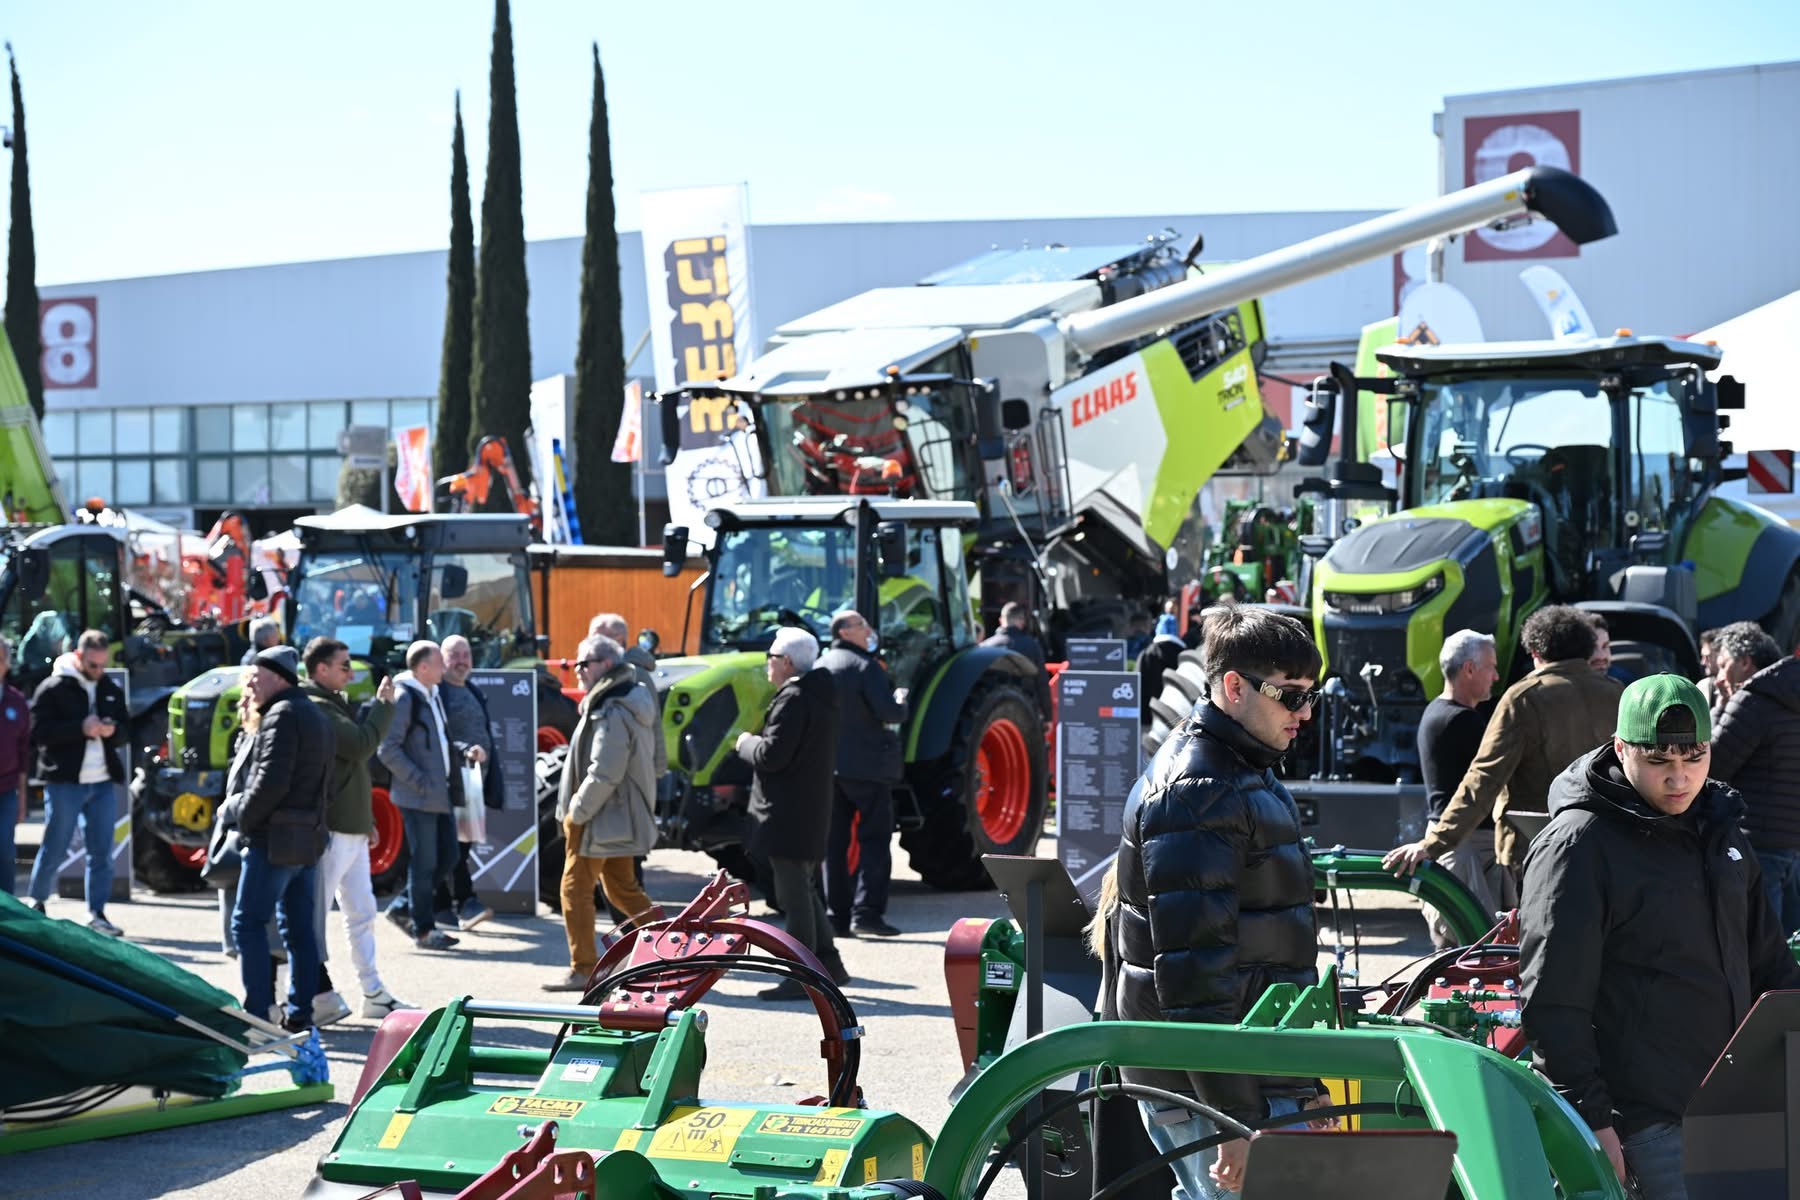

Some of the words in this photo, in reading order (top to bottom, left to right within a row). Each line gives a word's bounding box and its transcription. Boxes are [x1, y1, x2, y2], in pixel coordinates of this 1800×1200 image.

[42, 303, 93, 384] 8
[1072, 371, 1136, 428] CLAAS
[520, 1098, 578, 1112] FACMA
[688, 1111, 726, 1129] 50
[687, 1129, 705, 1140] m
[786, 1125, 802, 1133] TR
[804, 1126, 826, 1134] 160
